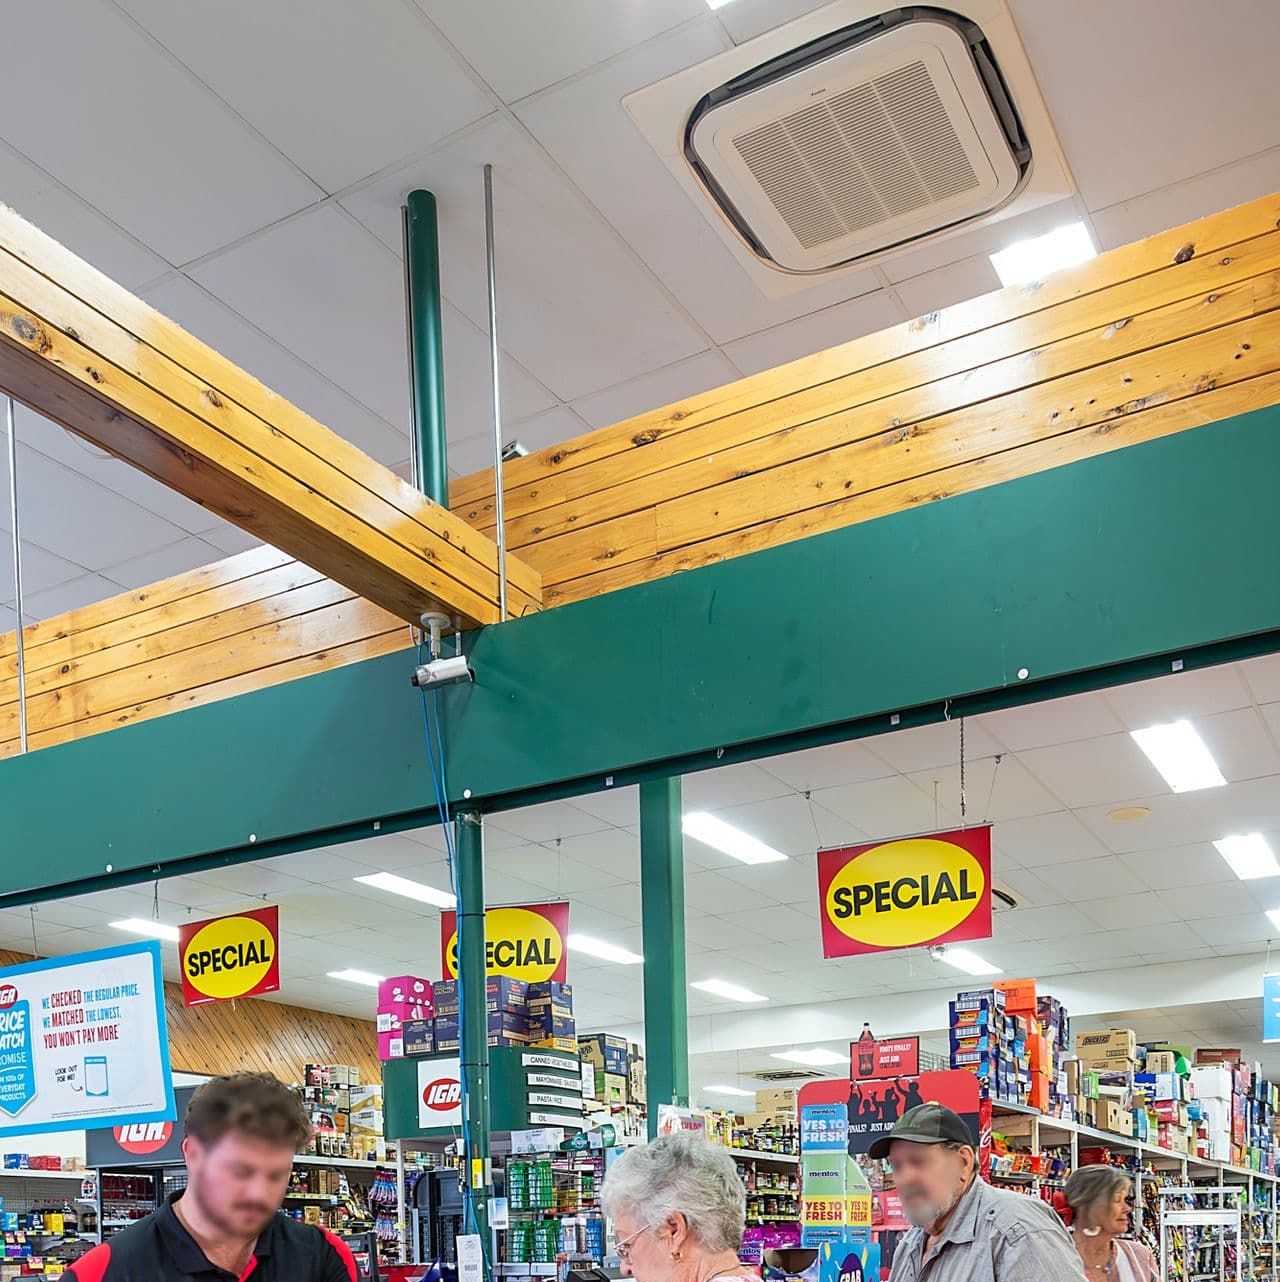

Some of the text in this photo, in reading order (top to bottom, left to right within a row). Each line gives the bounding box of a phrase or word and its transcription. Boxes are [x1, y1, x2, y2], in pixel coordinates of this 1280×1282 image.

[833, 869, 977, 919] SPECIAL
[187, 938, 271, 978] SPECIAL
[451, 937, 557, 971] ECIAL
[42, 998, 50, 1010] WE
[51, 989, 82, 1009] CHECKED
[83, 991, 94, 1003] THE
[95, 986, 121, 1001] REGULAR
[42, 1016, 51, 1029] WE
[52, 1008, 84, 1027] MATCHED
[86, 1010, 96, 1022] THE
[43, 1033, 58, 1050] YOU
[58, 1030, 83, 1048] WON'T
[83, 1027, 96, 1044] PAY
[530, 1056, 551, 1065] CANNED
[17, 1073, 25, 1081] OF
[427, 1083, 460, 1104] IGA
[119, 1121, 163, 1142] IGA
[803, 1120, 846, 1130] YES TO
[803, 1131, 846, 1143] FRESH
[805, 1201, 842, 1211] YES TO
[850, 1200, 860, 1211] YES
[805, 1211, 843, 1221] FRESH
[850, 1211, 868, 1221] FRESH
